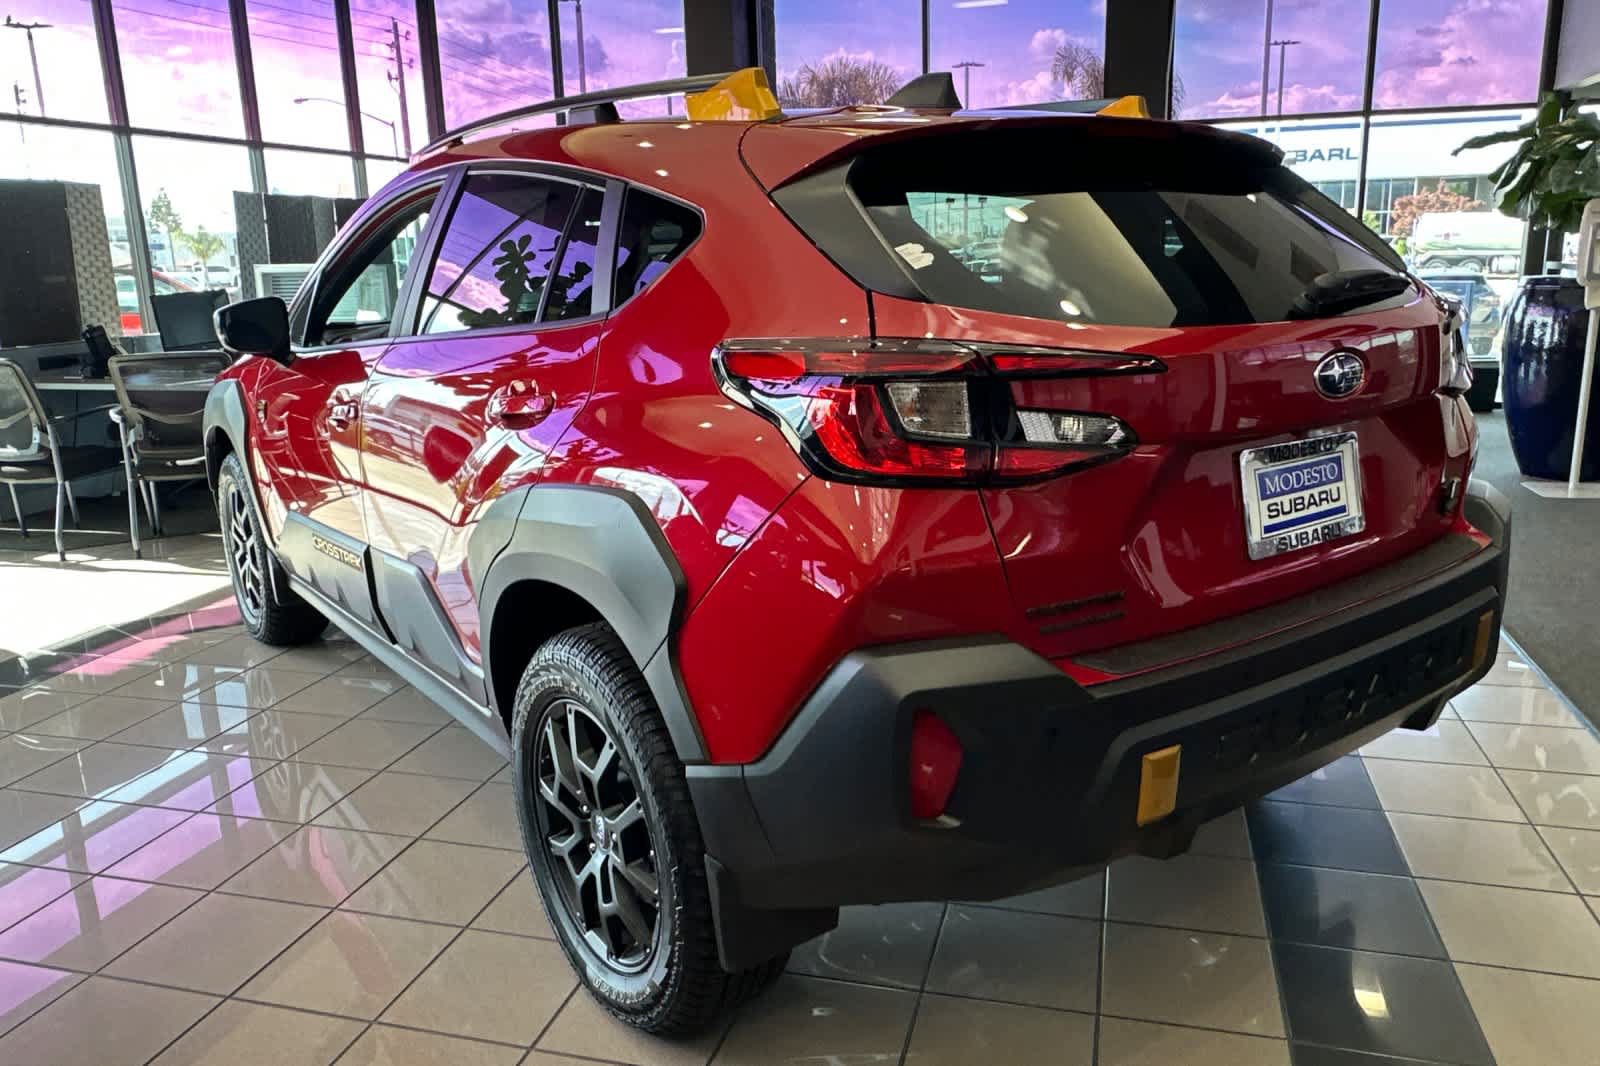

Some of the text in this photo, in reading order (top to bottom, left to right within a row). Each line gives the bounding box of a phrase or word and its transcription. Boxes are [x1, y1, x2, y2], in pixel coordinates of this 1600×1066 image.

[1265, 462, 1339, 495] MODESTO
[1267, 486, 1341, 519] SUBARU
[1276, 521, 1342, 552] SUBARU
